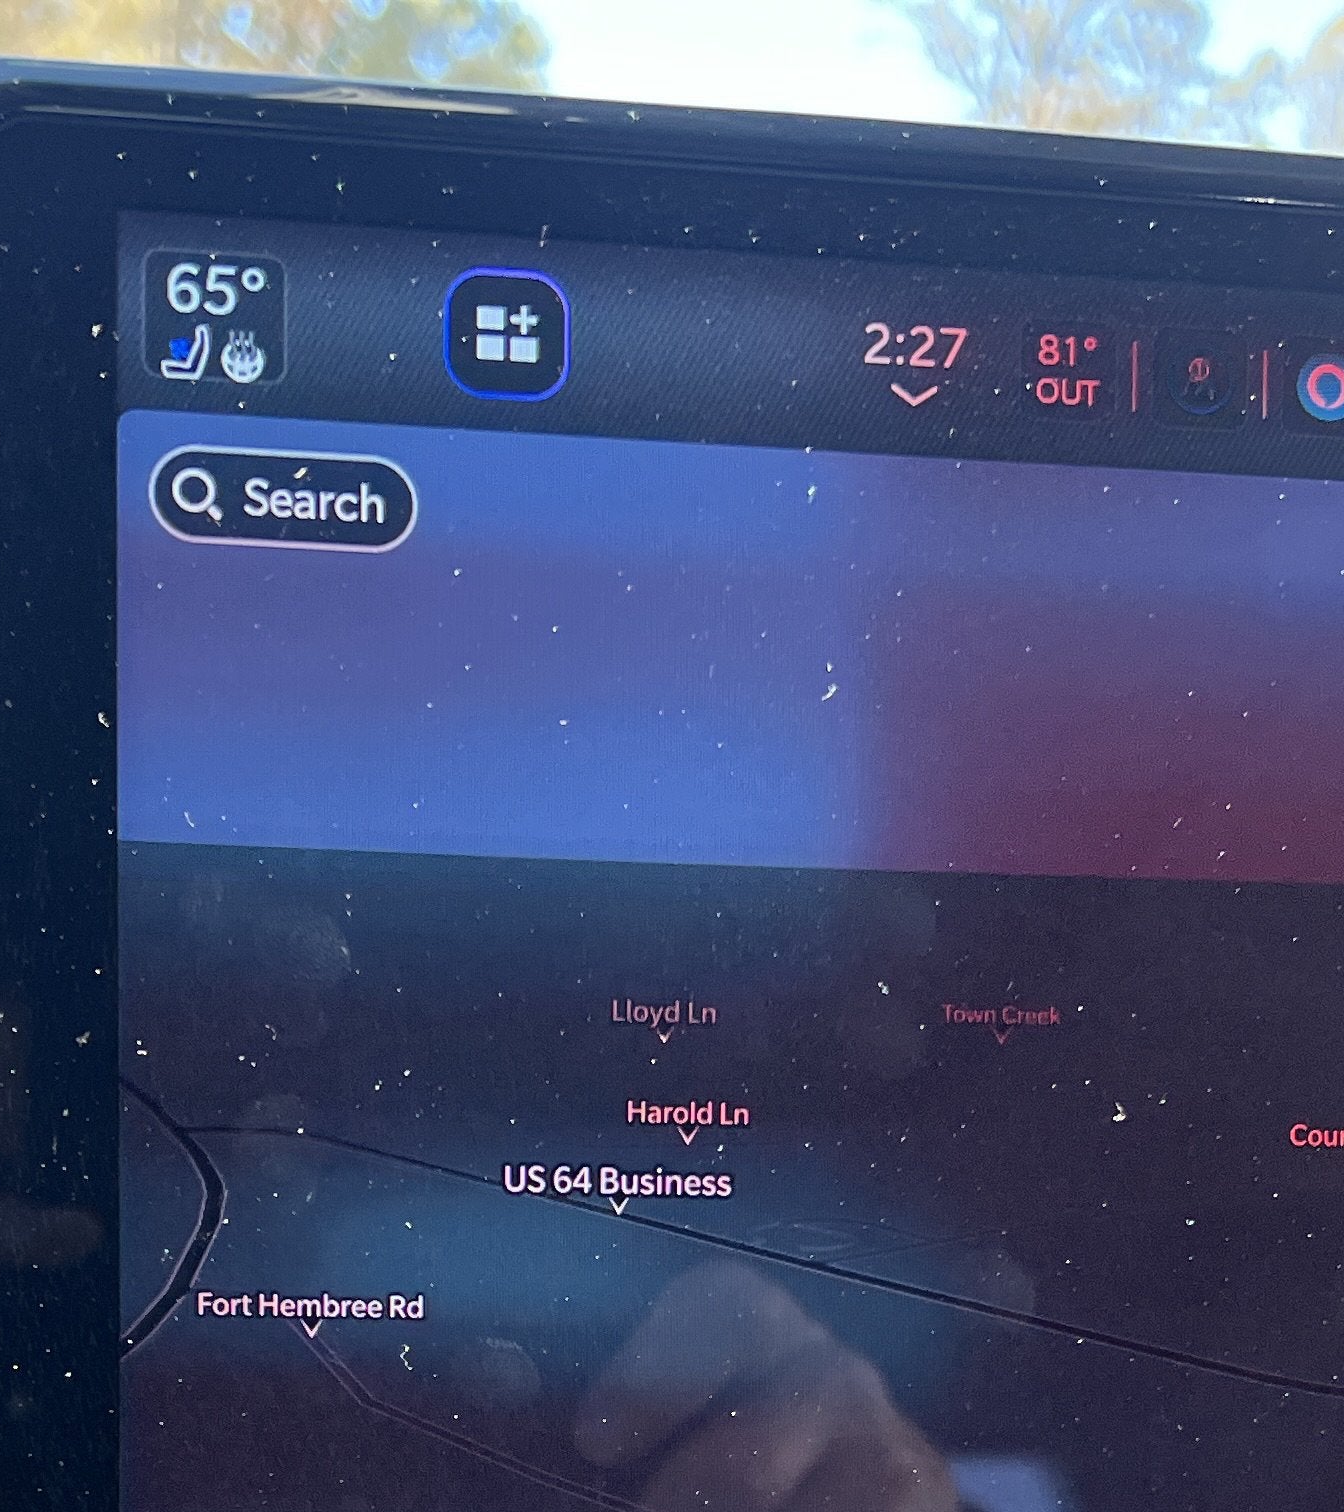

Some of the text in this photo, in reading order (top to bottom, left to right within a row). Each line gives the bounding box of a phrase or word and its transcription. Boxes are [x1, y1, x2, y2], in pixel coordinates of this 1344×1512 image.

[166, 262, 267, 316] 65°
[864, 322, 968, 368] 2:27
[1038, 334, 1098, 367] 81°
[1036, 377, 1101, 407] OUT
[243, 478, 386, 524] Search
[612, 1000, 717, 1028] Lloyd Ln
[943, 1003, 996, 1024] Town
[627, 1101, 750, 1125] Harold Ln
[504, 1165, 732, 1196] US 64 Business
[197, 1292, 424, 1319] Fort Hembree Rd
